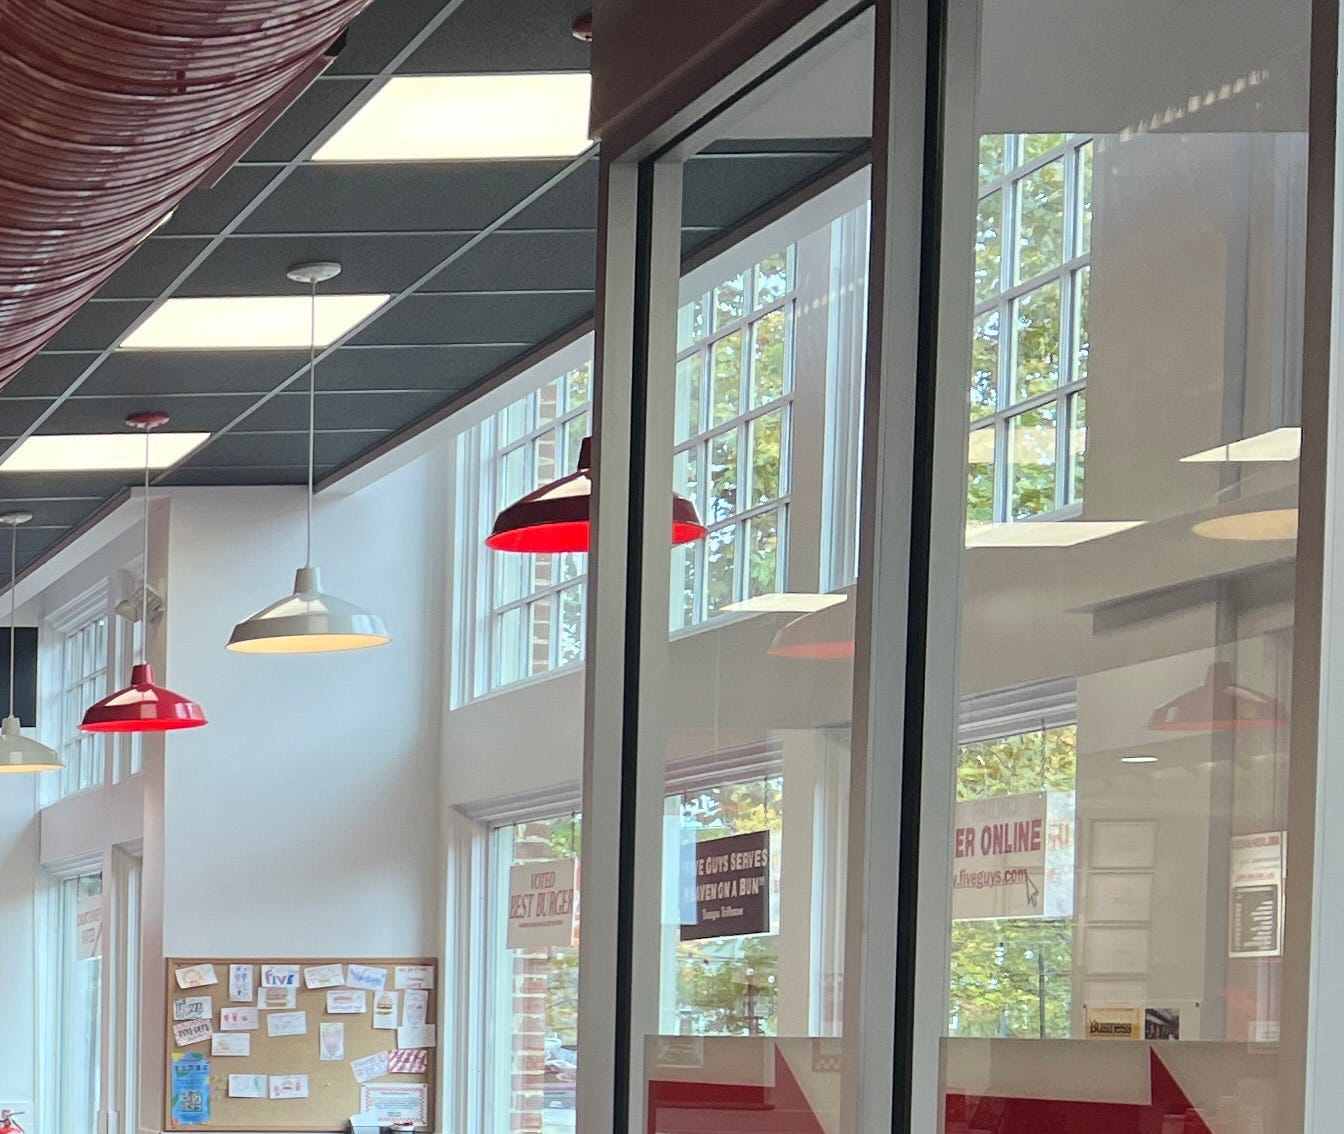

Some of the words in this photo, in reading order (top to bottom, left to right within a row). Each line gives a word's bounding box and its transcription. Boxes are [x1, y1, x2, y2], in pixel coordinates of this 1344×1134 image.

[981, 818, 1042, 856] ONLINE
[705, 854, 729, 875] GUYS
[730, 848, 768, 871] SERVES
[530, 871, 555, 889] VOTED
[954, 868, 1027, 889] .fiveguys.com
[718, 881, 730, 900] ON
[731, 880, 737, 897] A
